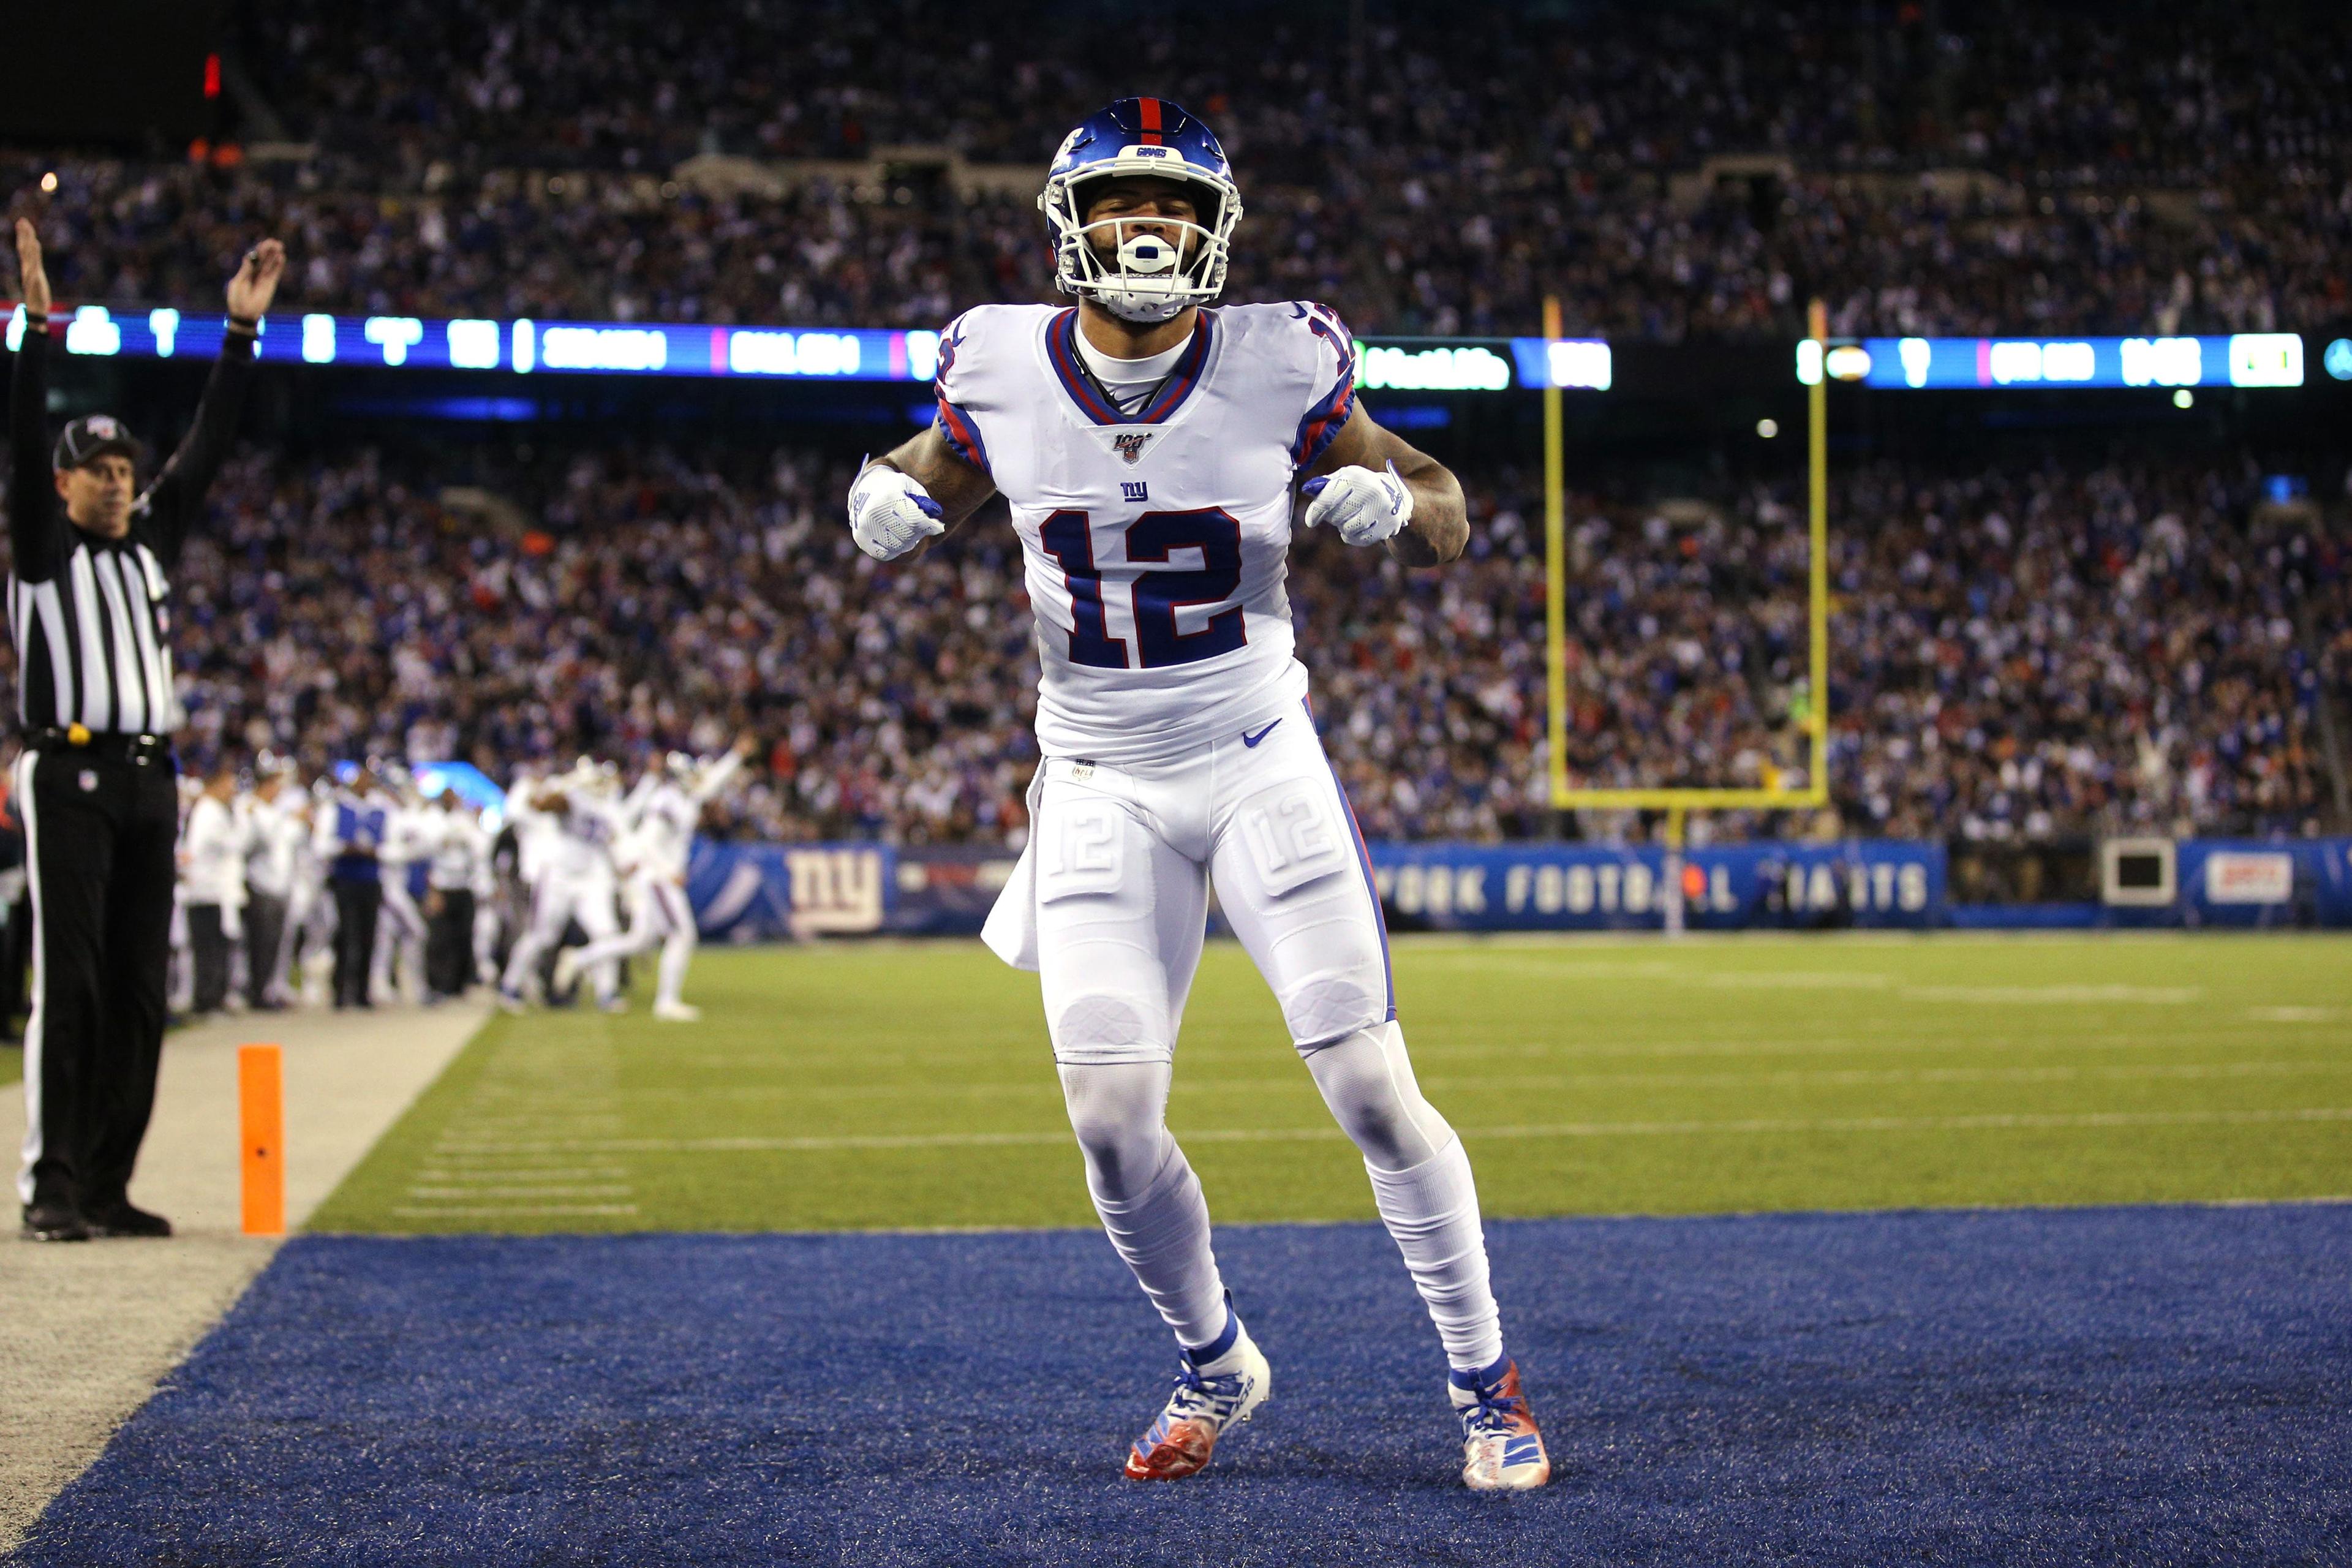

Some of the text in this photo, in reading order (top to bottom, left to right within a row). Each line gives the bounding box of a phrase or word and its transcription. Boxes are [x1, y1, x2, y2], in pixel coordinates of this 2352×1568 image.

[1039, 506, 1248, 669] 12
[1047, 806, 1114, 876] 12
[1250, 793, 1335, 873] 12
